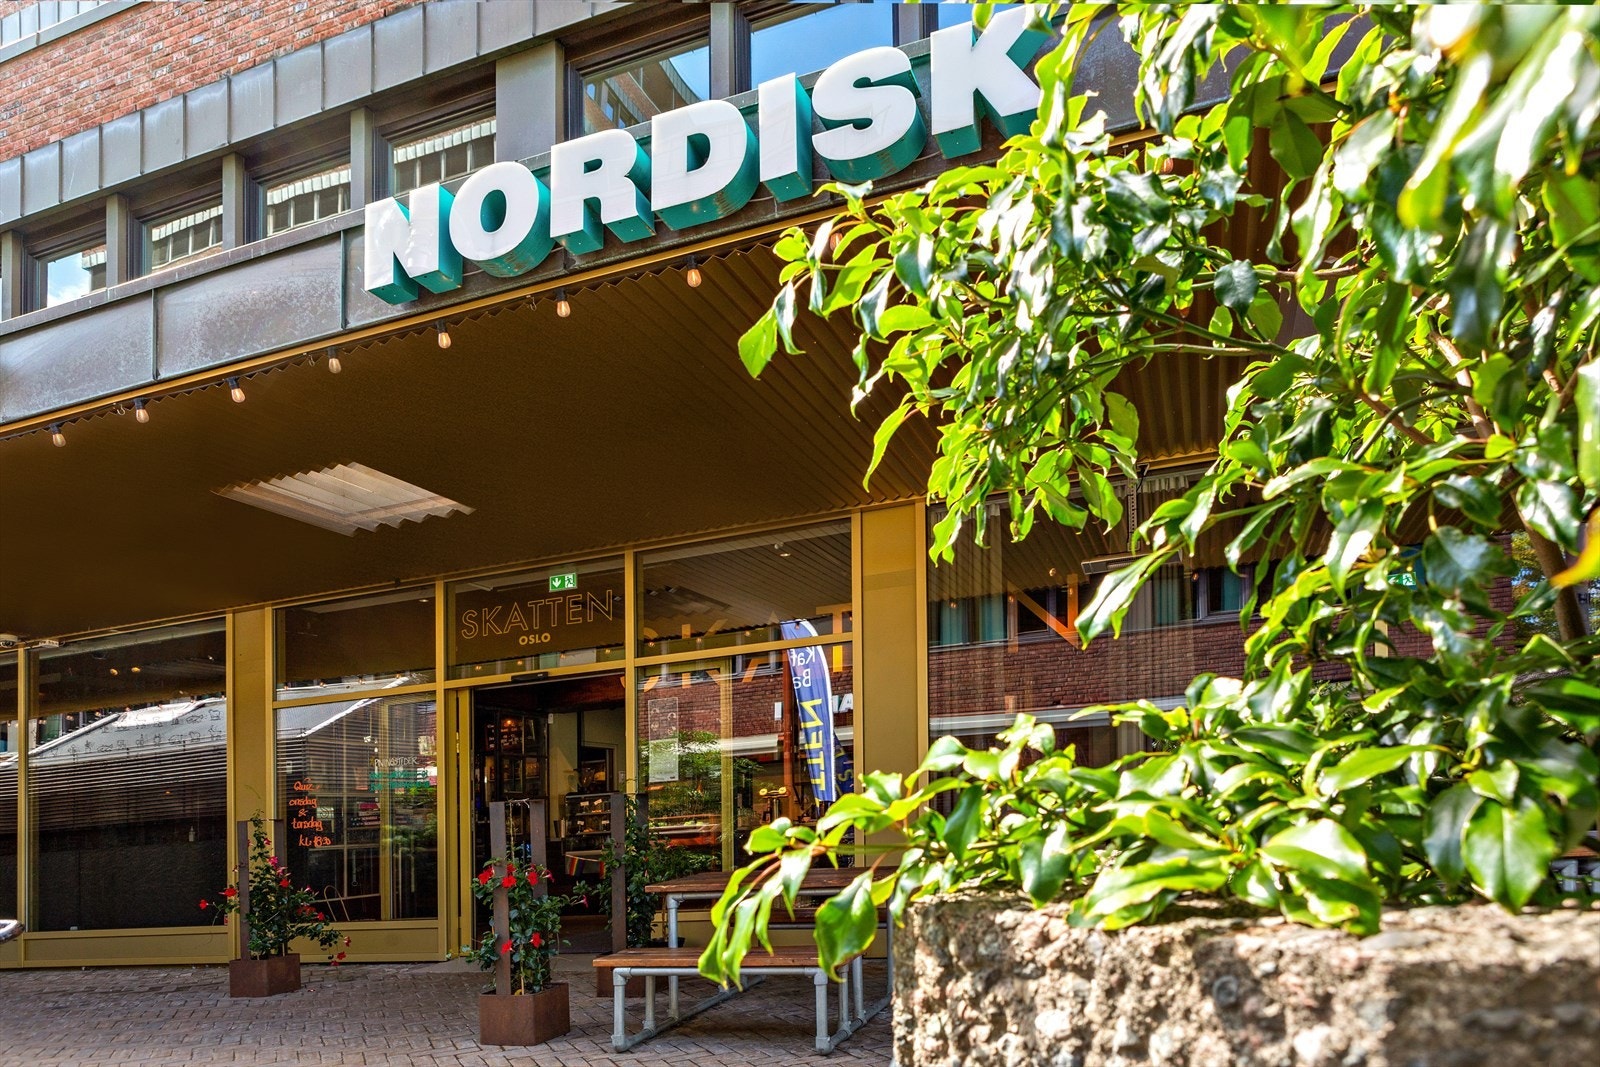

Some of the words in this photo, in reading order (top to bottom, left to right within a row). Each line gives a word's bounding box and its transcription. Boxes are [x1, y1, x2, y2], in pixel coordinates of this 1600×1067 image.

[364, 6, 1045, 304] NORDISK
[461, 589, 613, 639] SKATTEN
[518, 632, 551, 646] OSLO
